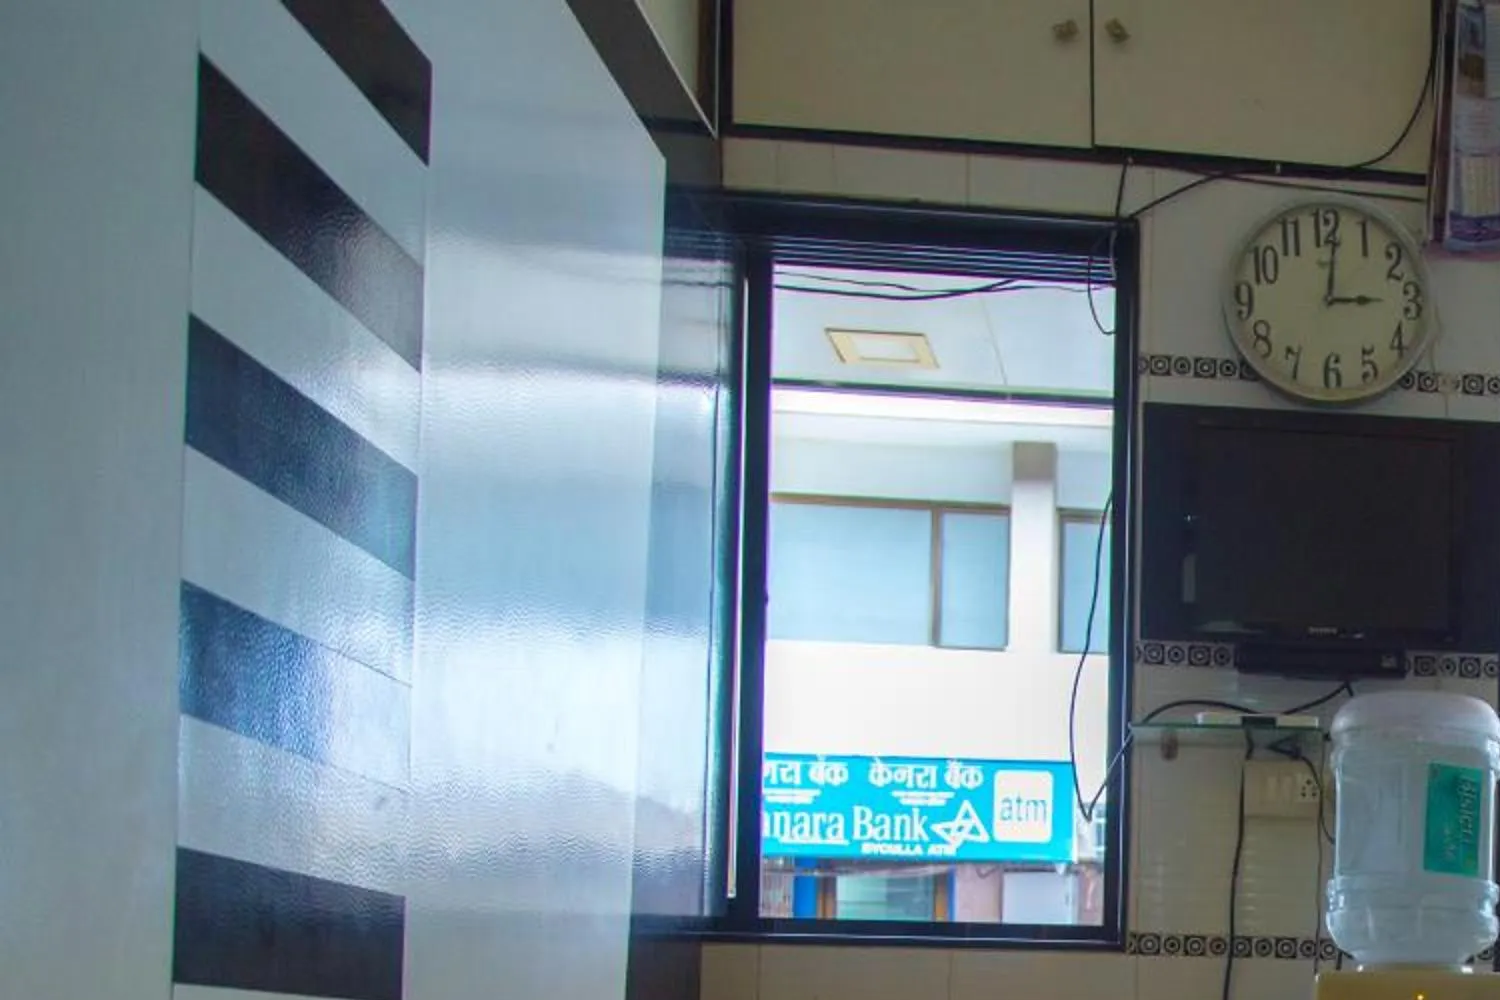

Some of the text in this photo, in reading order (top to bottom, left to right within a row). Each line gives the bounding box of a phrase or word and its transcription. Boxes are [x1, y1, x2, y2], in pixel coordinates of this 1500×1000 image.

[1278, 217, 1300, 257] 11
[1310, 208, 1340, 248] 12
[1356, 220, 1369, 257] 1
[1253, 245, 1279, 285] 10
[1384, 241, 1404, 282] 2
[1234, 281, 1254, 321] 9
[1402, 281, 1423, 321] 3
[1252, 319, 1273, 359] 8
[1389, 319, 1407, 359] 4
[1285, 345, 1303, 381] 7
[1323, 351, 1342, 389] 6
[1361, 344, 1379, 384] 5
[853, 805, 930, 842] Bank
[1000, 796, 1047, 822] atm
